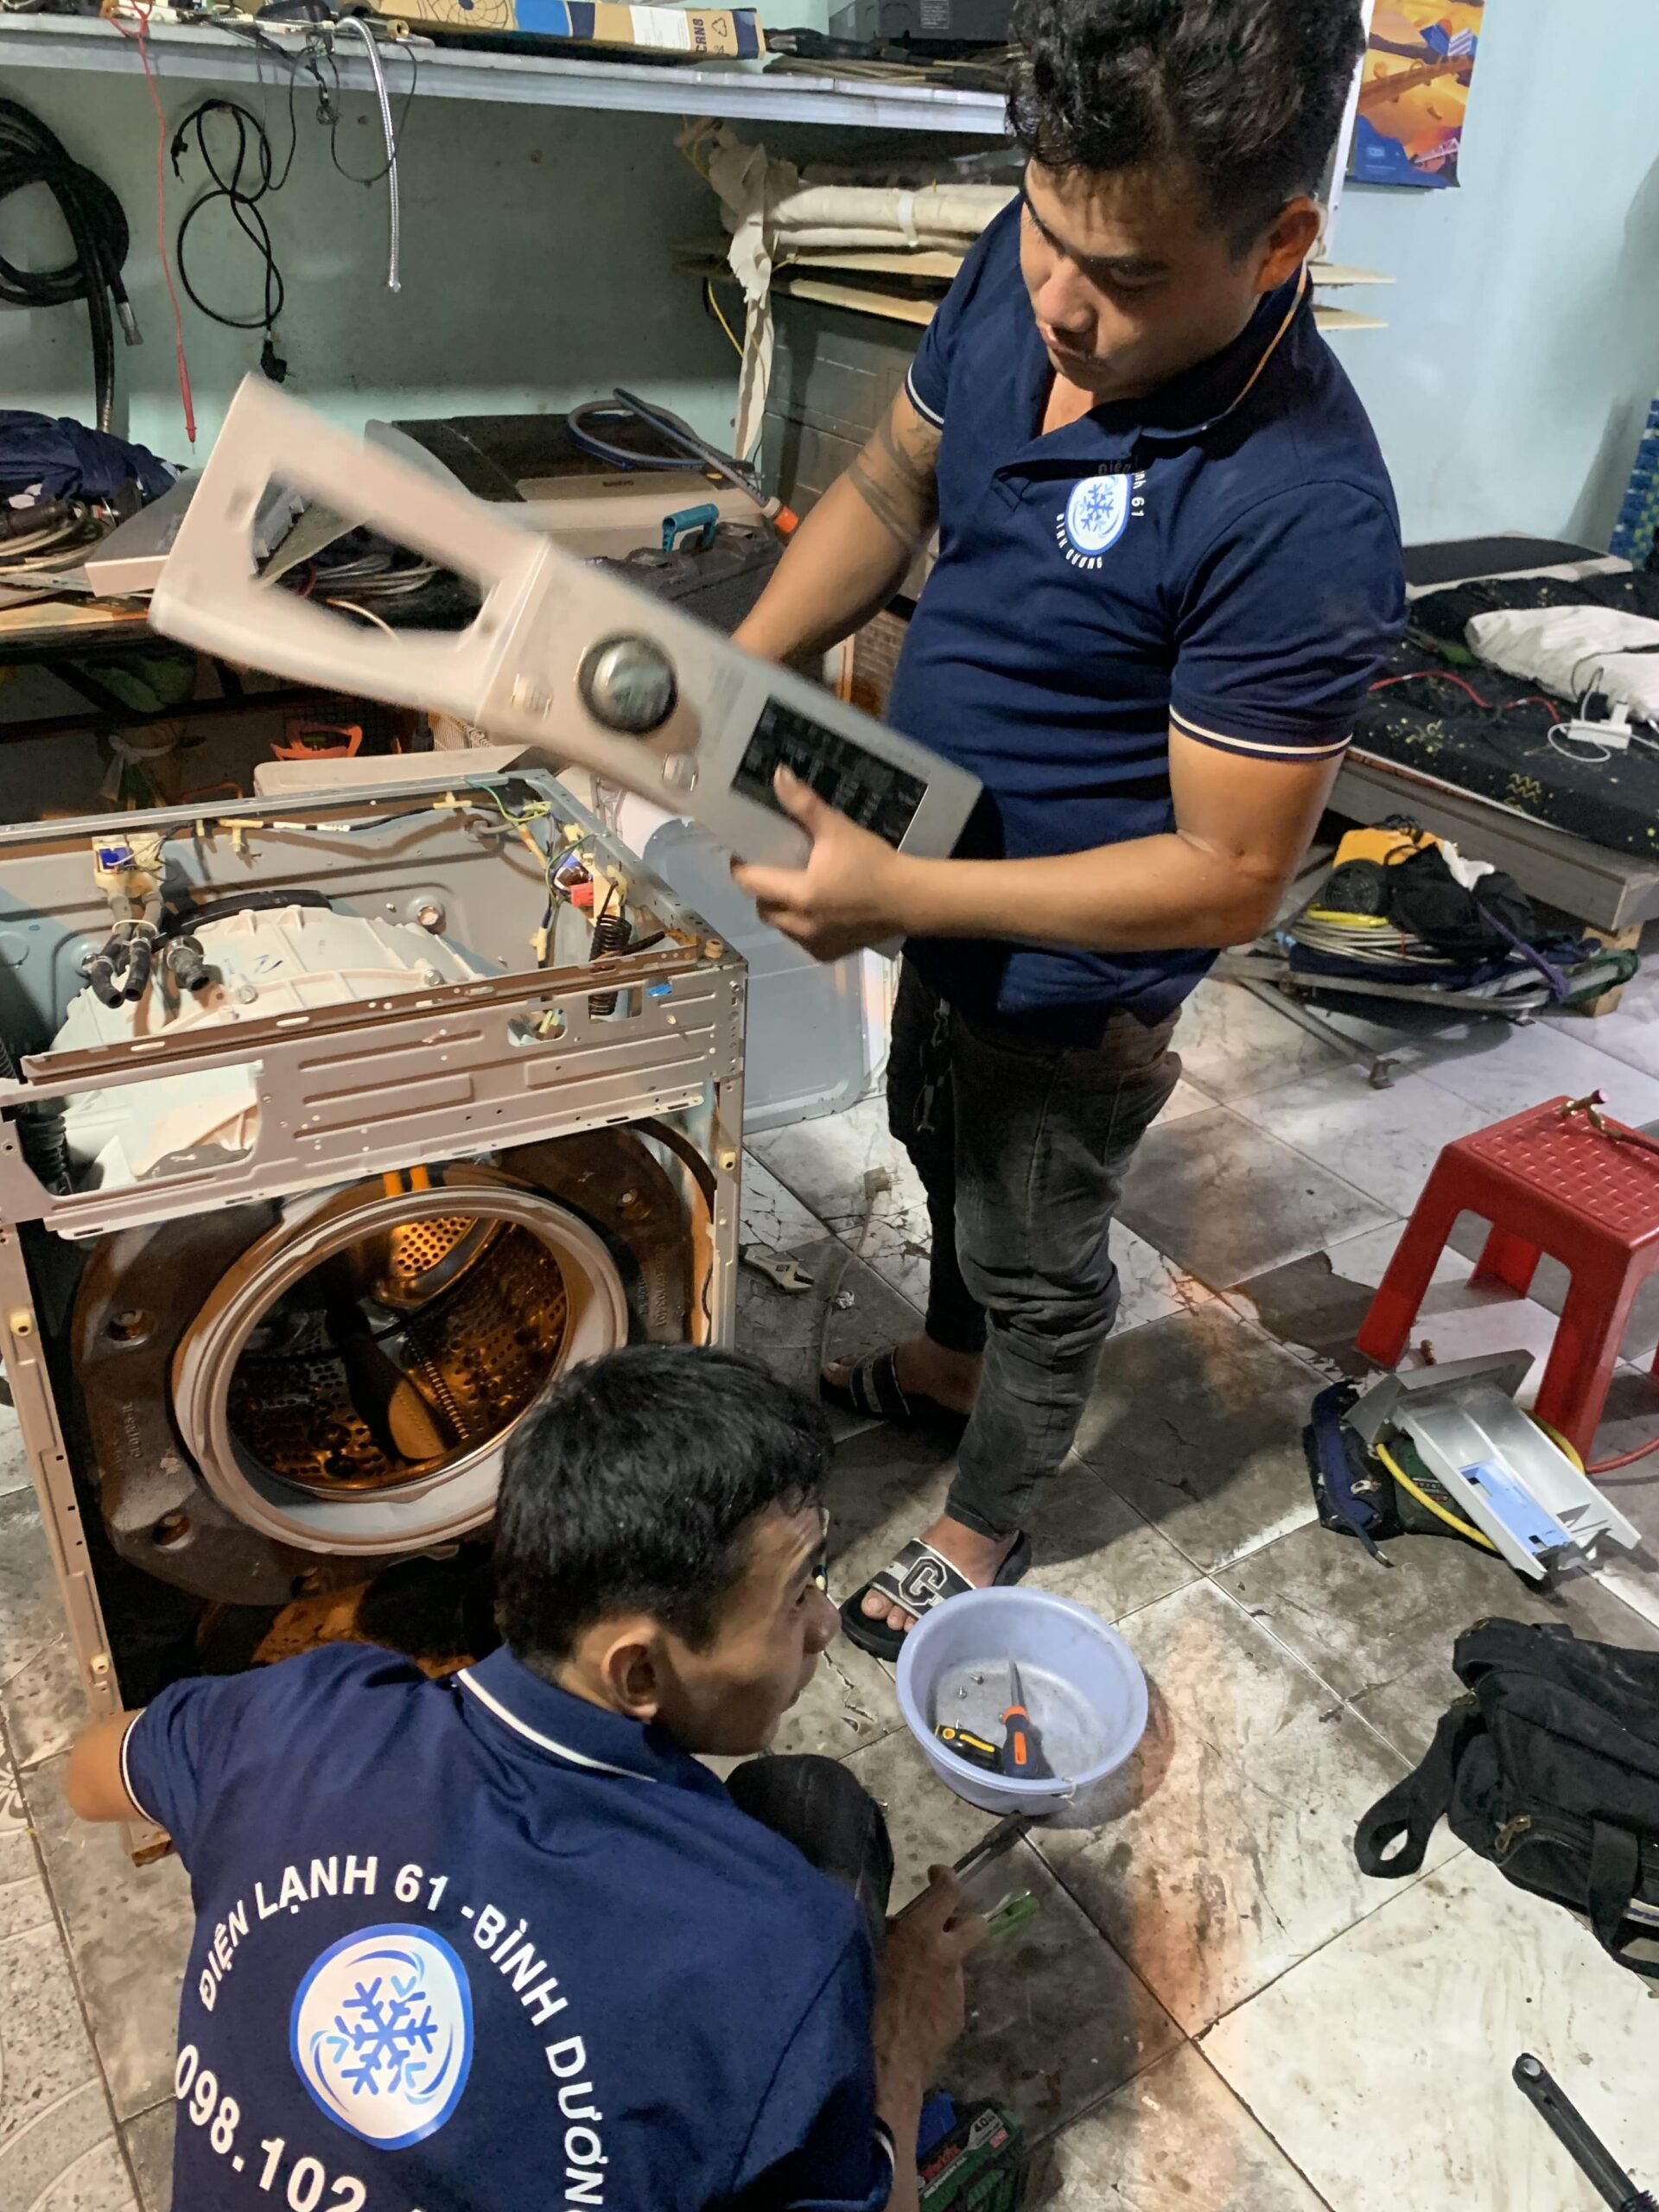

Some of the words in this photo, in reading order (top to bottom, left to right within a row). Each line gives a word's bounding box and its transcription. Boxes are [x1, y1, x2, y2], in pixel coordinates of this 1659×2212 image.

[1131, 497, 1145, 517] 61
[898, 1556, 947, 1605] G
[199, 1901, 249, 2012] ĐIỆN
[255, 1855, 378, 1920] LẠNH
[394, 1863, 449, 1910] 61
[545, 2035, 609, 2212] DƯƠN
[175, 2044, 423, 2212] 098.102
